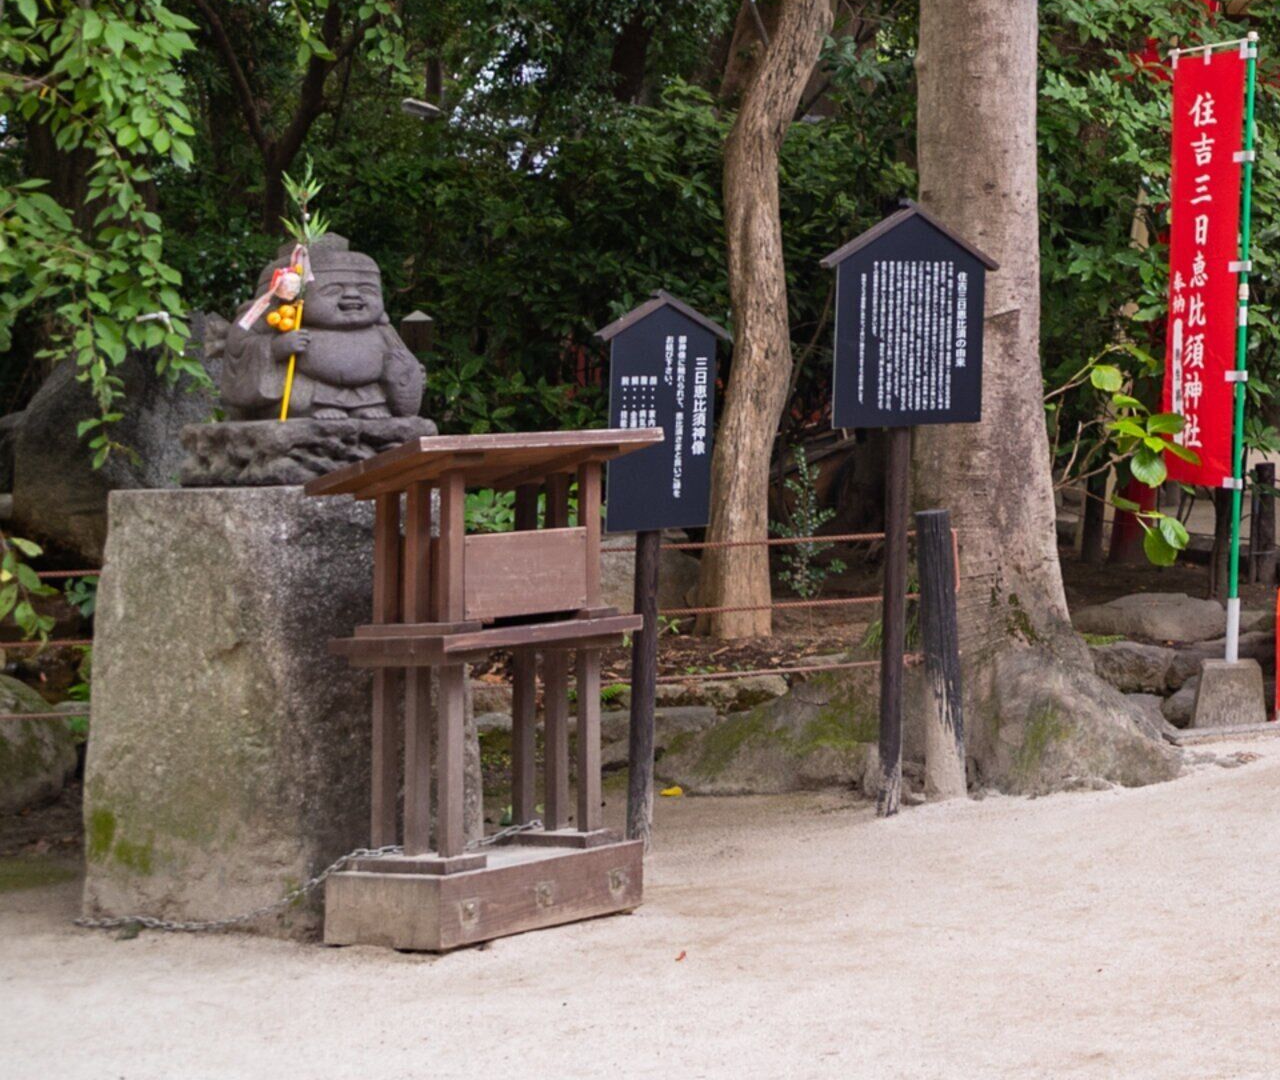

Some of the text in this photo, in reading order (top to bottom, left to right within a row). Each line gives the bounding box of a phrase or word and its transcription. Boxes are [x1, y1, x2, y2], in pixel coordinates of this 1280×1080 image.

[1183, 91, 1217, 447] 住吉三日恵比須神社
[955, 271, 968, 368] 住吉三日恵比須の由来
[691, 357, 708, 456] 三日恵比須神像
